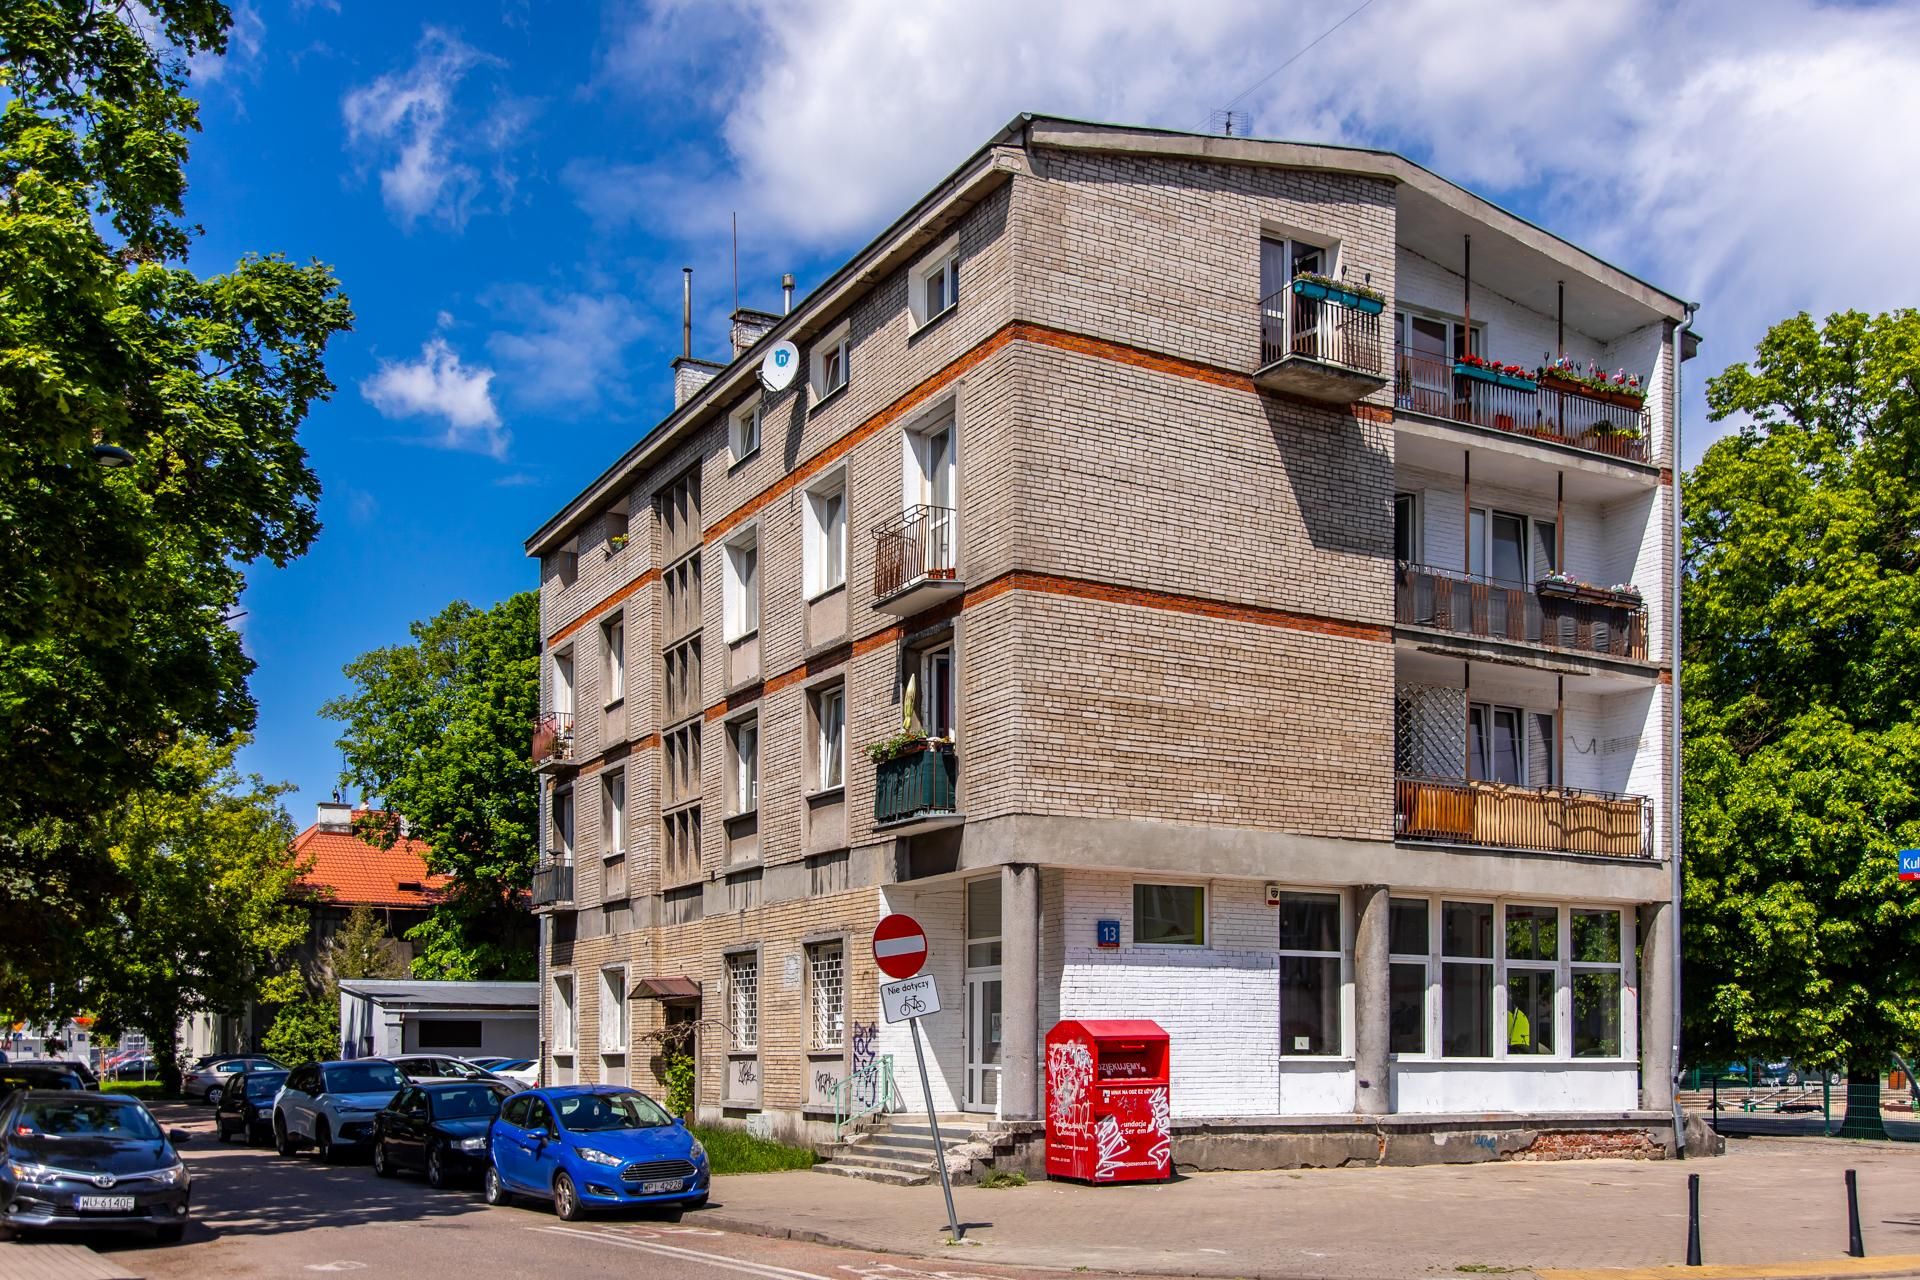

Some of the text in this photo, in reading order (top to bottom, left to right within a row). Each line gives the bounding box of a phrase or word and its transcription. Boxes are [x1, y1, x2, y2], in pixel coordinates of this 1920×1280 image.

[1103, 926, 1117, 942] 13
[887, 980, 929, 996] Nie dotyczy
